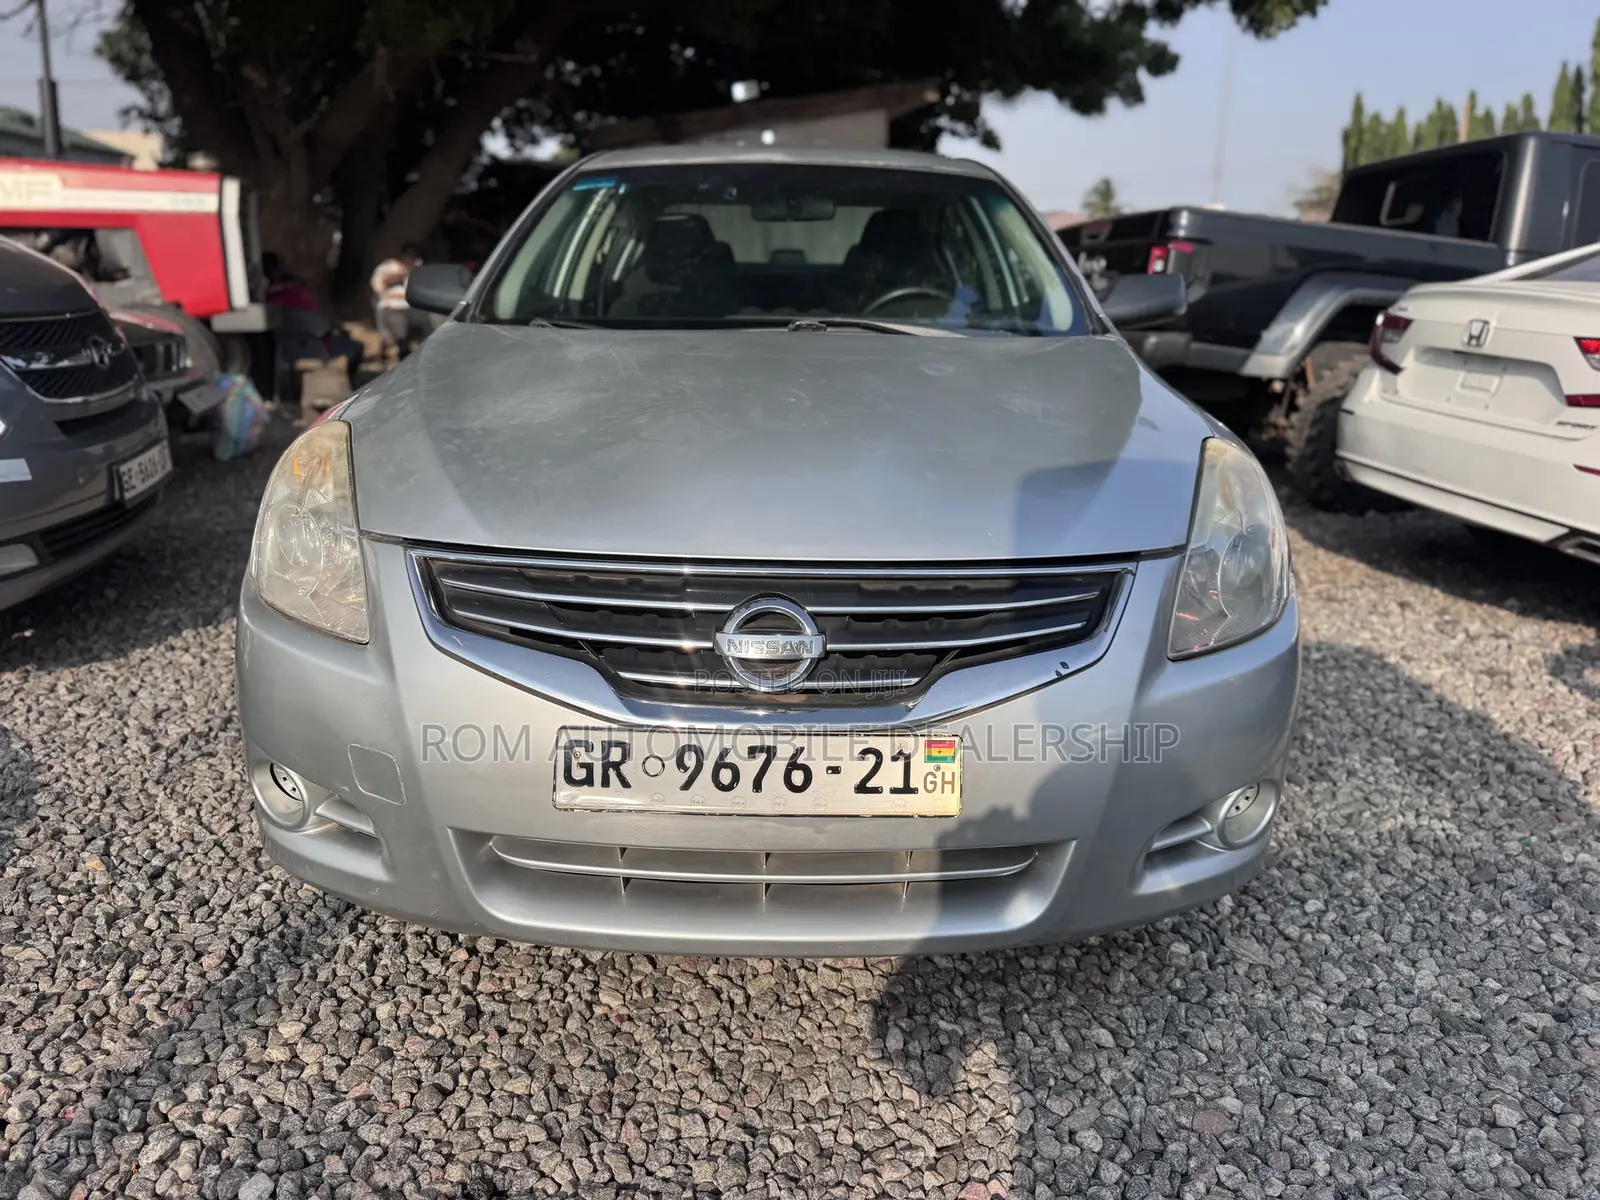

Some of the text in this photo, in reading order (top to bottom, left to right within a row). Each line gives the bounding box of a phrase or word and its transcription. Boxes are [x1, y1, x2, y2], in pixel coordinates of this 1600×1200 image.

[726, 638, 814, 654] NISSAN
[563, 739, 632, 789] GR
[923, 771, 955, 794] GH
